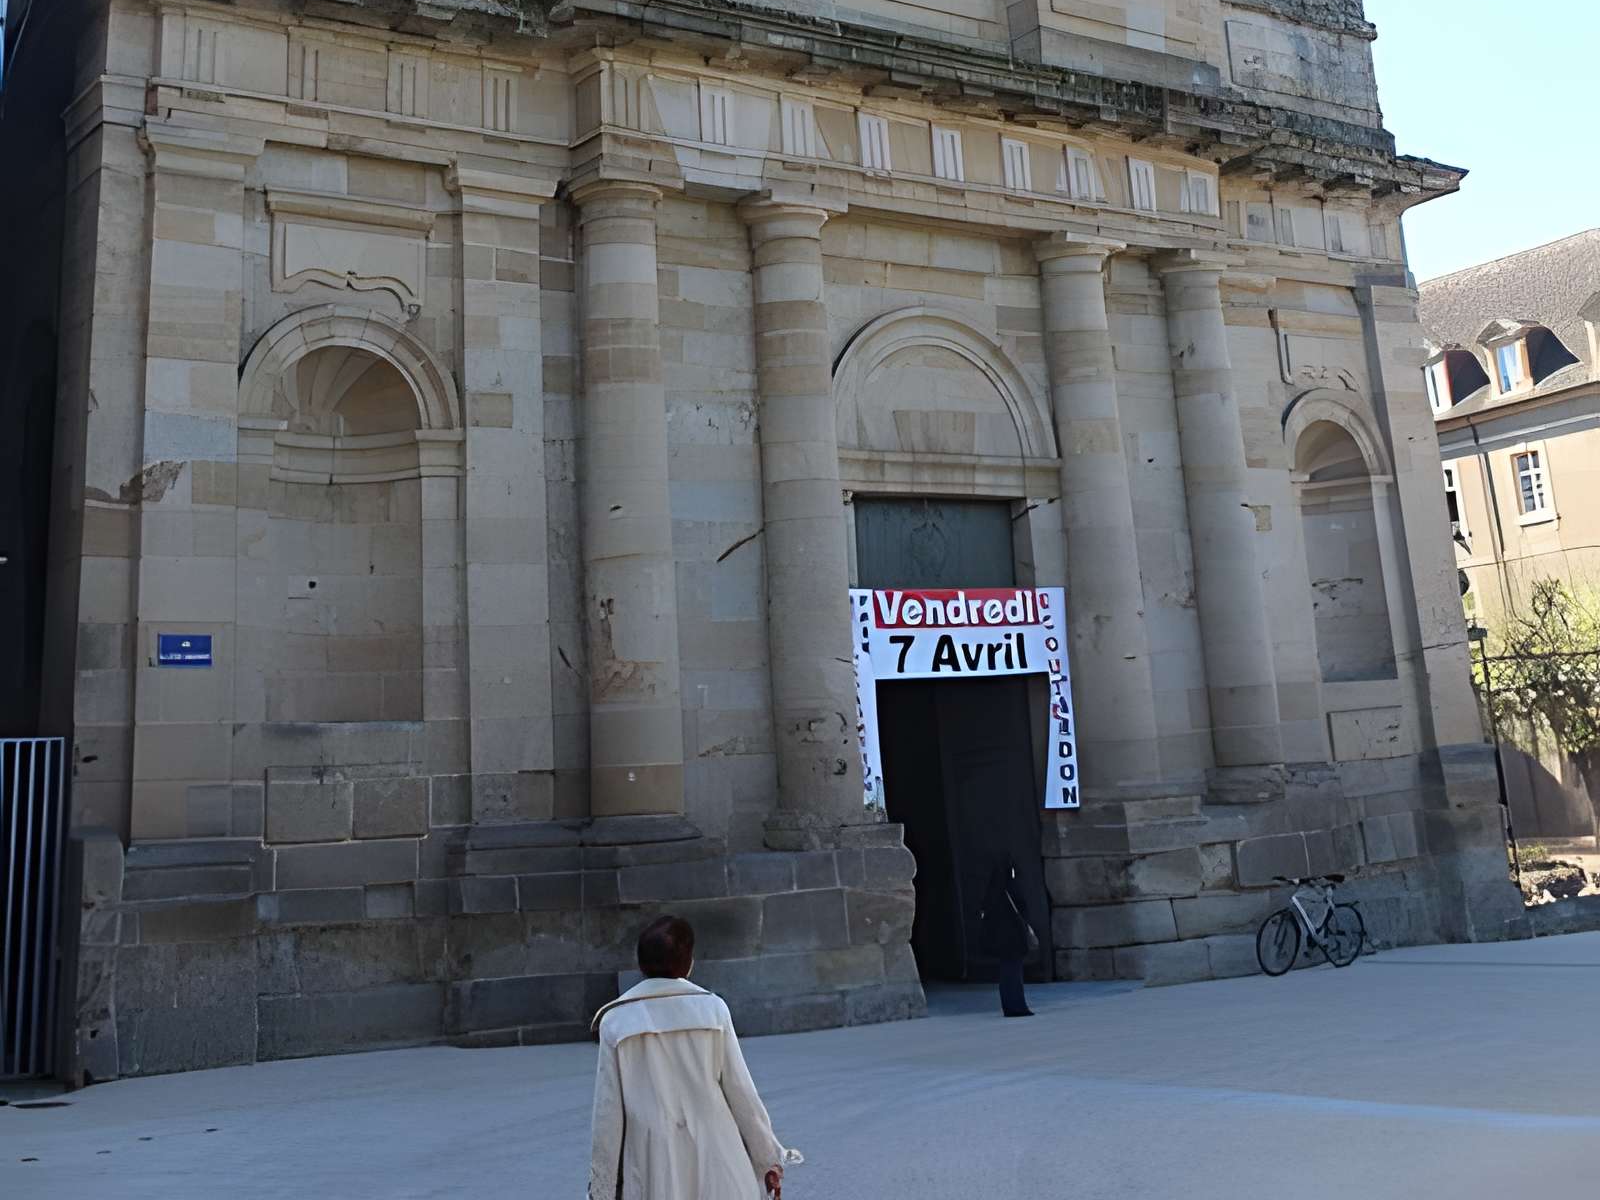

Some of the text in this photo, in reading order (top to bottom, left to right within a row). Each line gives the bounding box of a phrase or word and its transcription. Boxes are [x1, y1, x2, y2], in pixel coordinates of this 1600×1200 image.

[875, 590, 1034, 626] Vendredi
[889, 632, 1029, 674] 7 Avril
